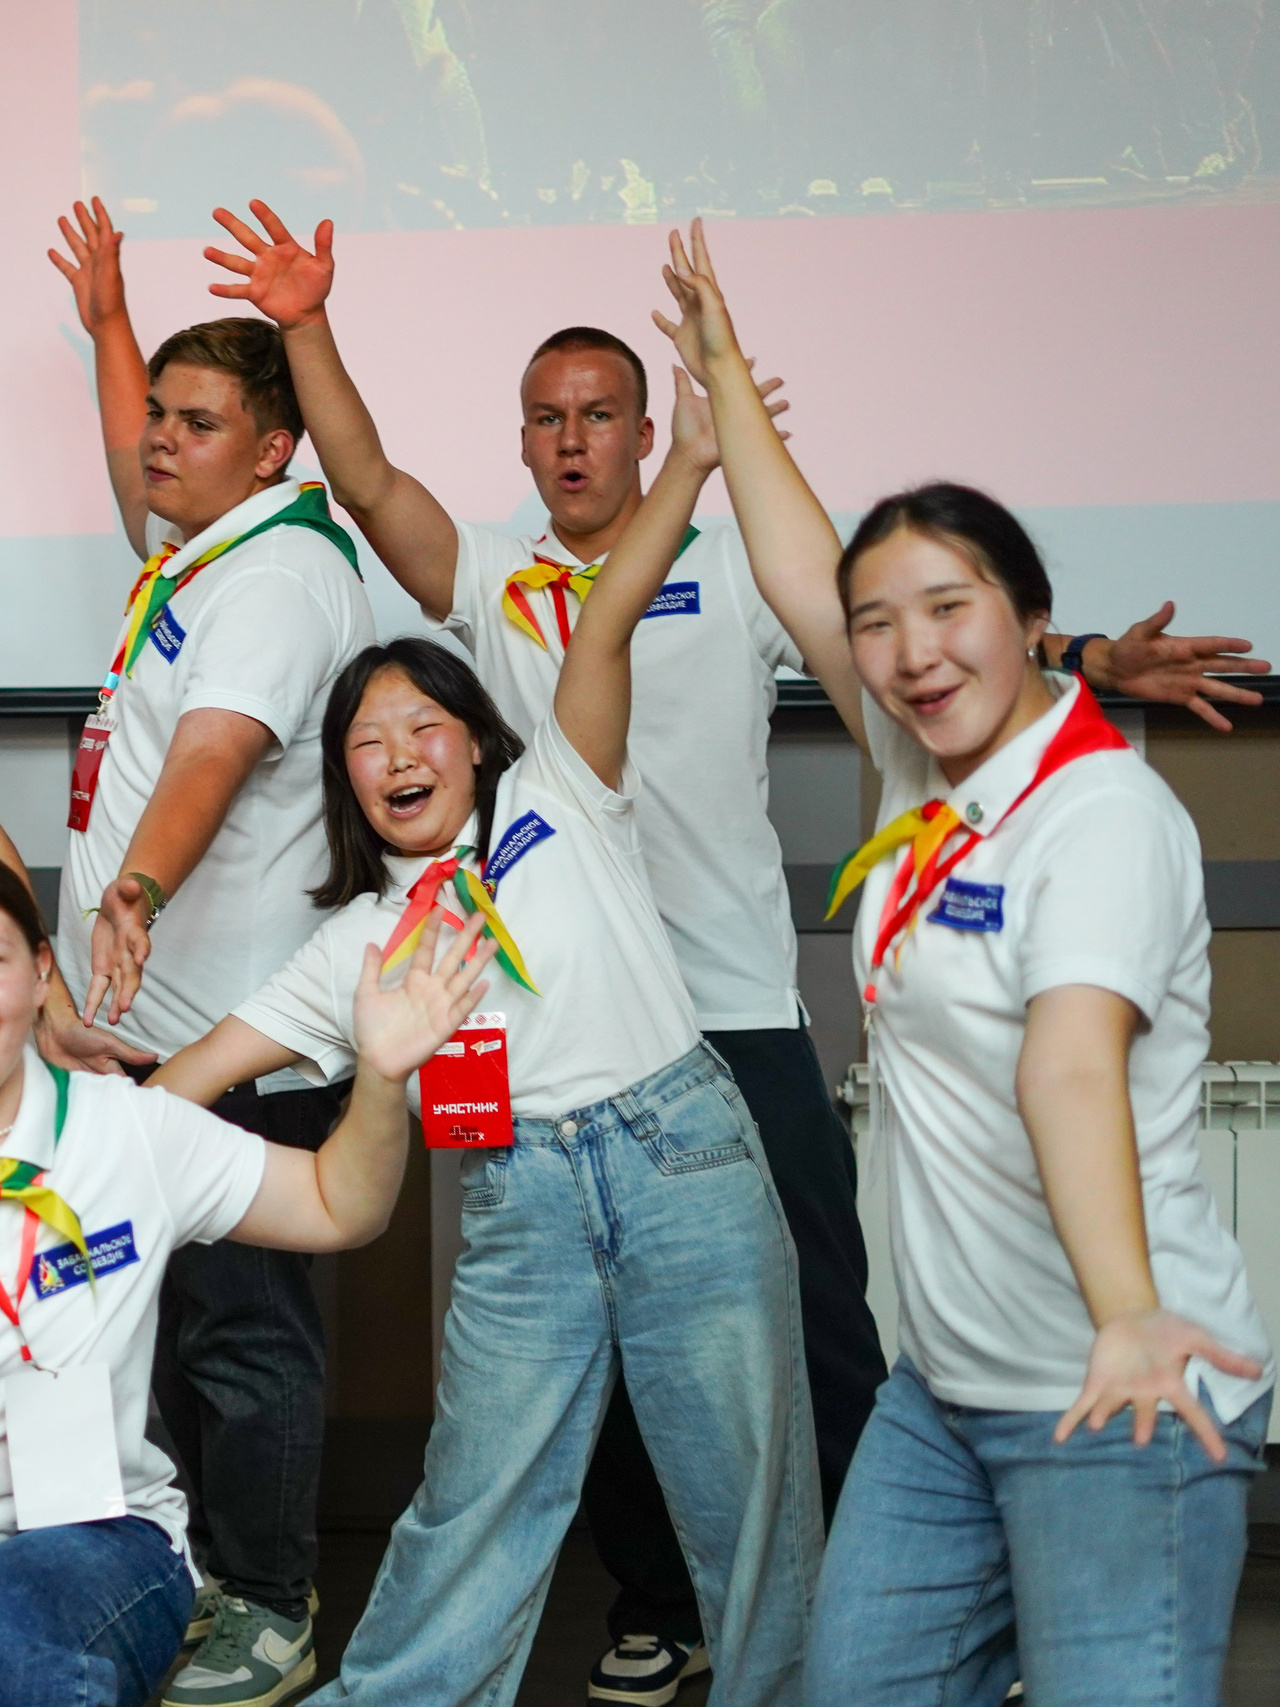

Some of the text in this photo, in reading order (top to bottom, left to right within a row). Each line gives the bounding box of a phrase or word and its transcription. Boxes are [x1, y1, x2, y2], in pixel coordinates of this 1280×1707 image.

[489, 818, 542, 876] ЗАБАЙКАЛЬСКОЕ
[432, 1102, 499, 1115] УЧАСТНИК
[56, 1233, 132, 1270] ЗАБАКАЛЬСКОЕ
[73, 1249, 126, 1276] СОВЕЗДИЕ
